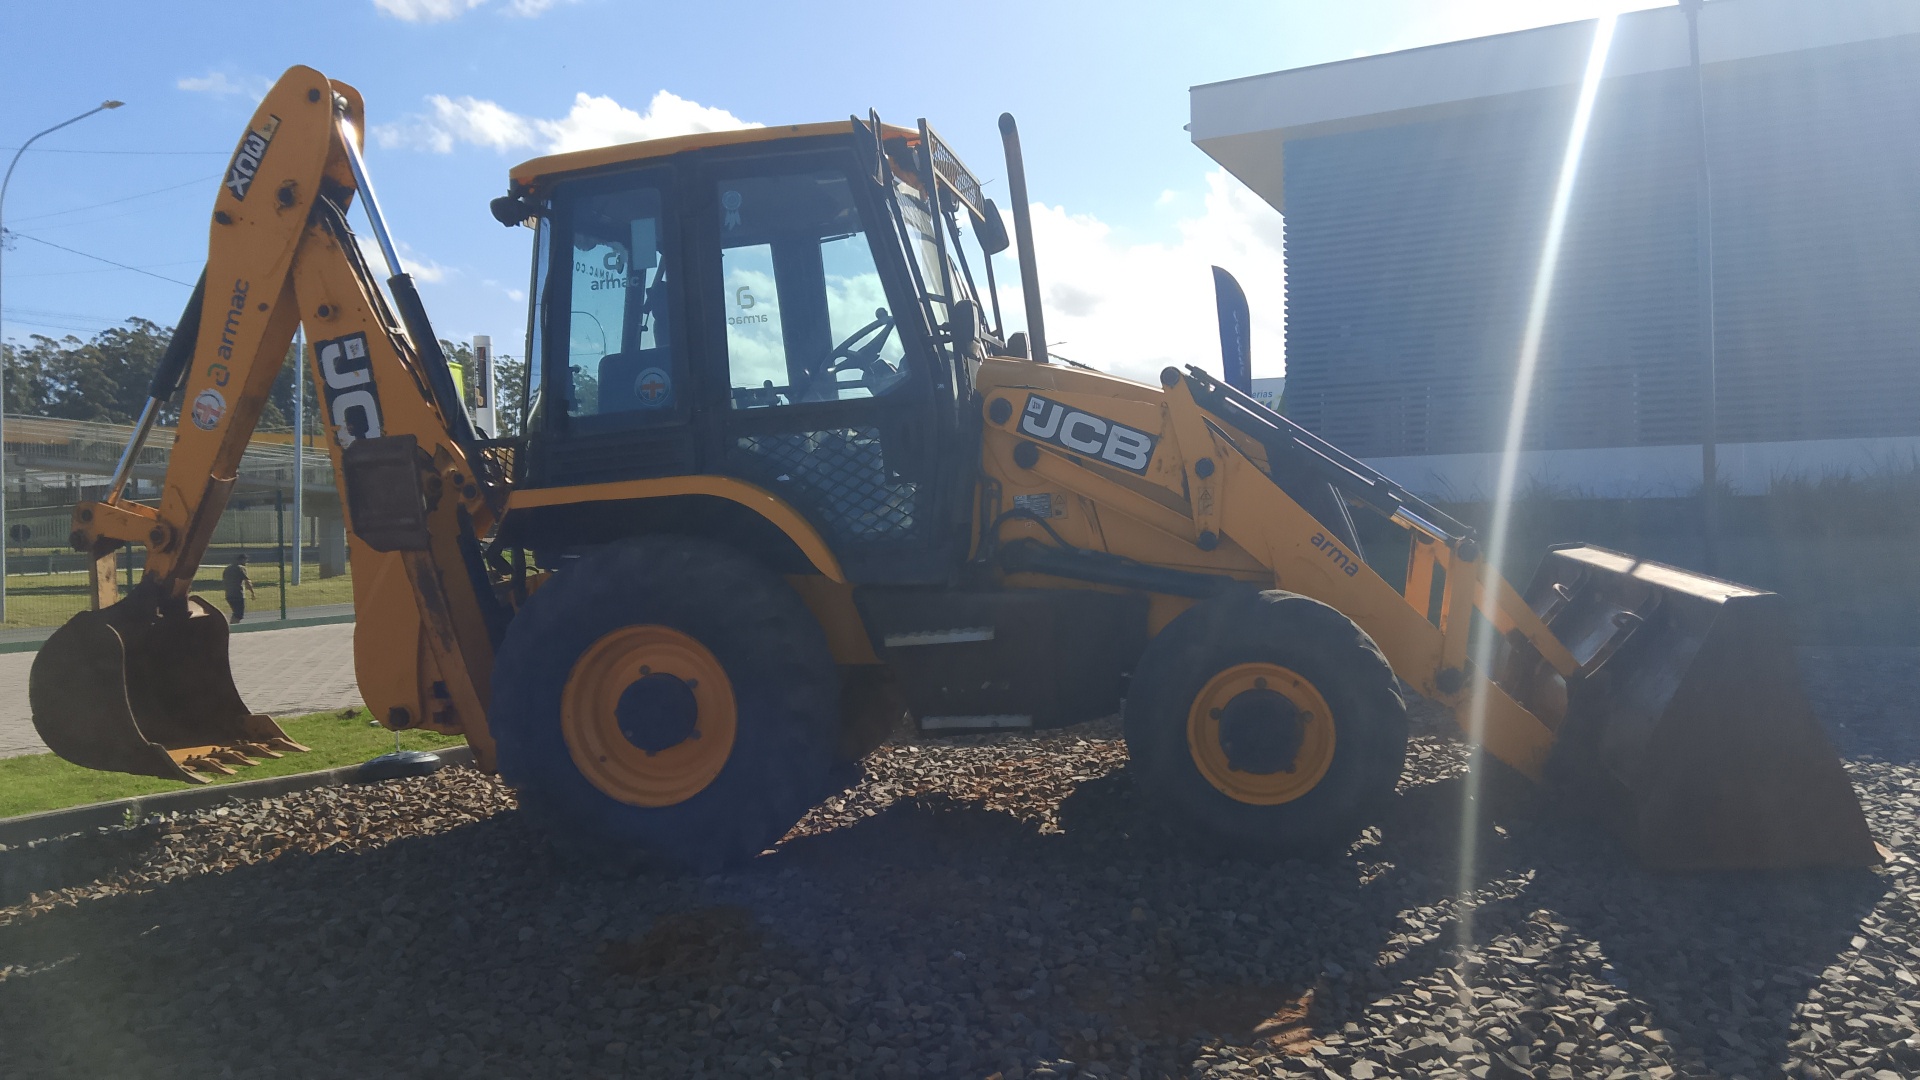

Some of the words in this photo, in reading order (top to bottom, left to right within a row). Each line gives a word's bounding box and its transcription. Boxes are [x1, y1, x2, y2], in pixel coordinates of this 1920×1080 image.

[590, 276, 640, 291] armac
[217, 279, 249, 360] armac
[321, 337, 381, 450] JC
[1252, 391, 1273, 399] erias
[1022, 397, 1152, 470] JCB
[1310, 532, 1359, 577] arma
